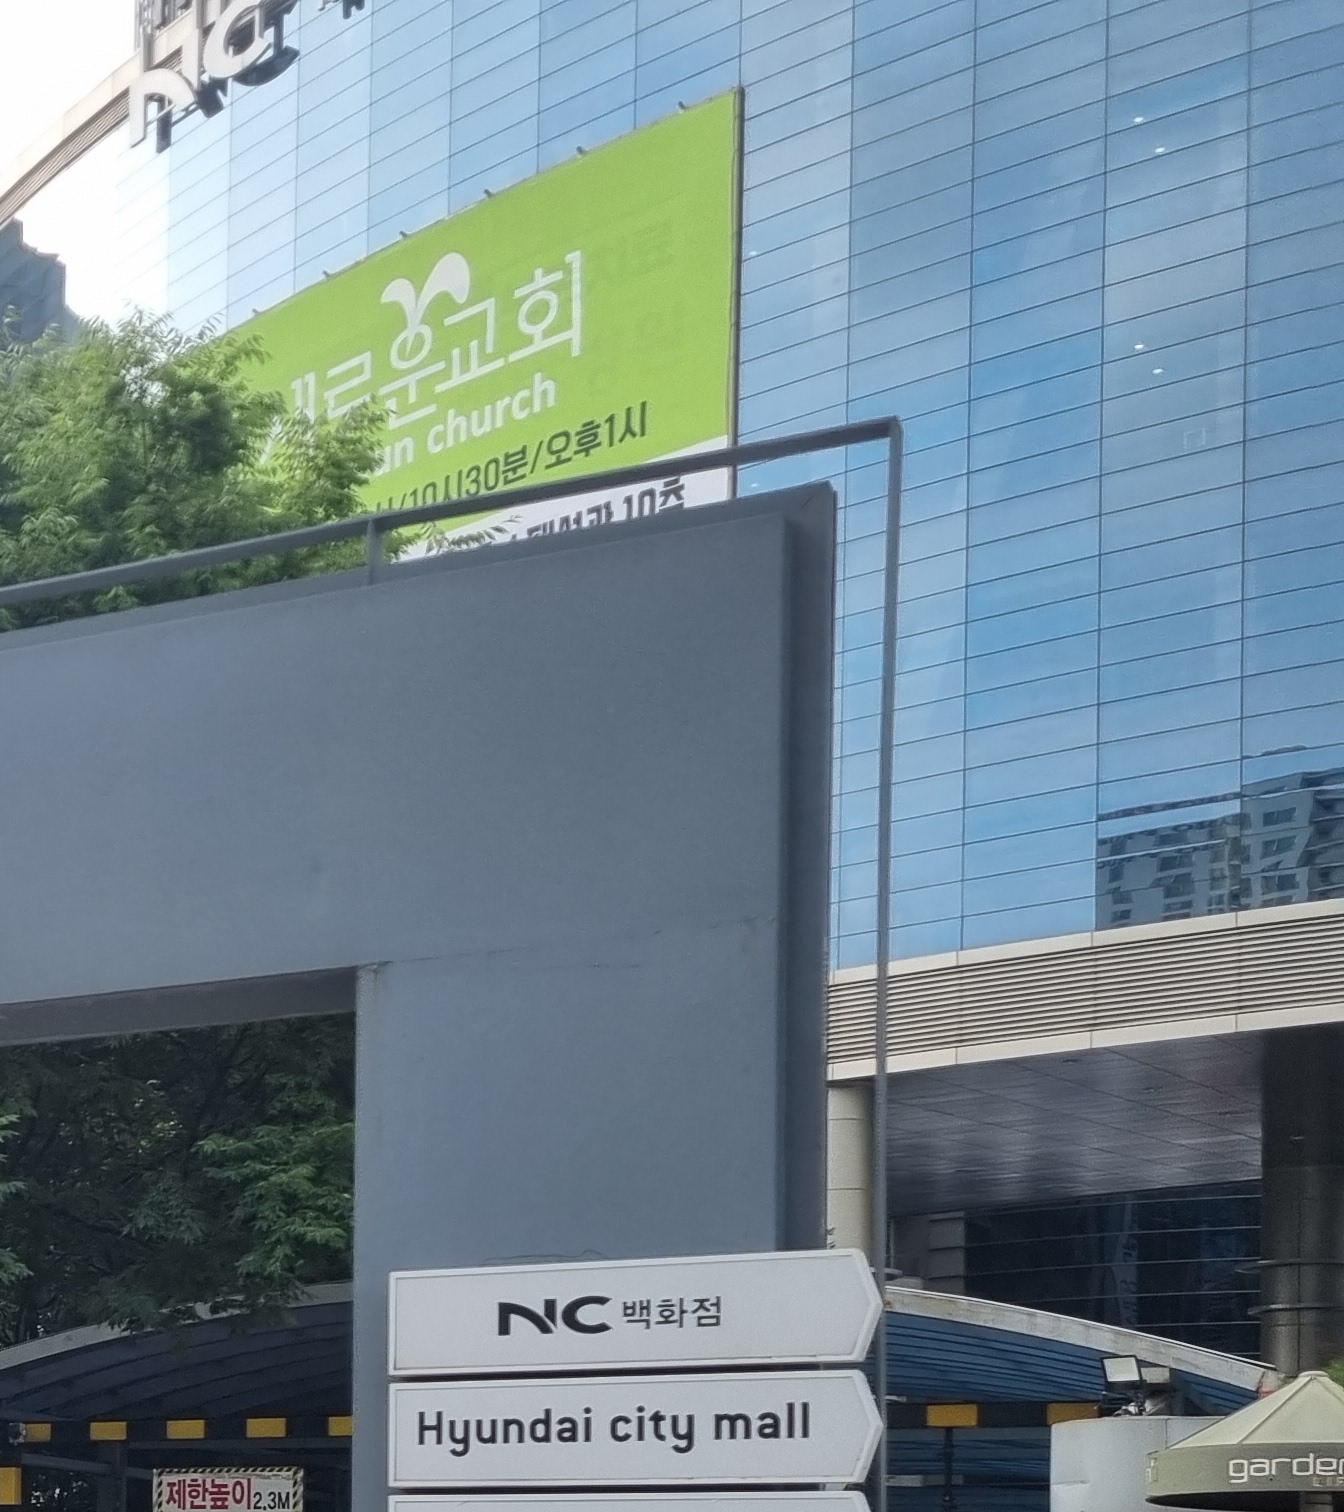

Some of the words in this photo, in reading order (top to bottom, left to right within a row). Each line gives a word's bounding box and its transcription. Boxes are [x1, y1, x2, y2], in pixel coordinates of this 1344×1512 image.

[427, 371, 557, 452] church
[497, 1295, 612, 1336] NC
[621, 1295, 722, 1330] 백화점
[417, 1407, 593, 1457] Hyundai
[610, 1405, 696, 1454] city
[714, 1401, 812, 1441] mall
[166, 1478, 251, 1511] 제한높이
[253, 1491, 290, 1510] 2.3M
